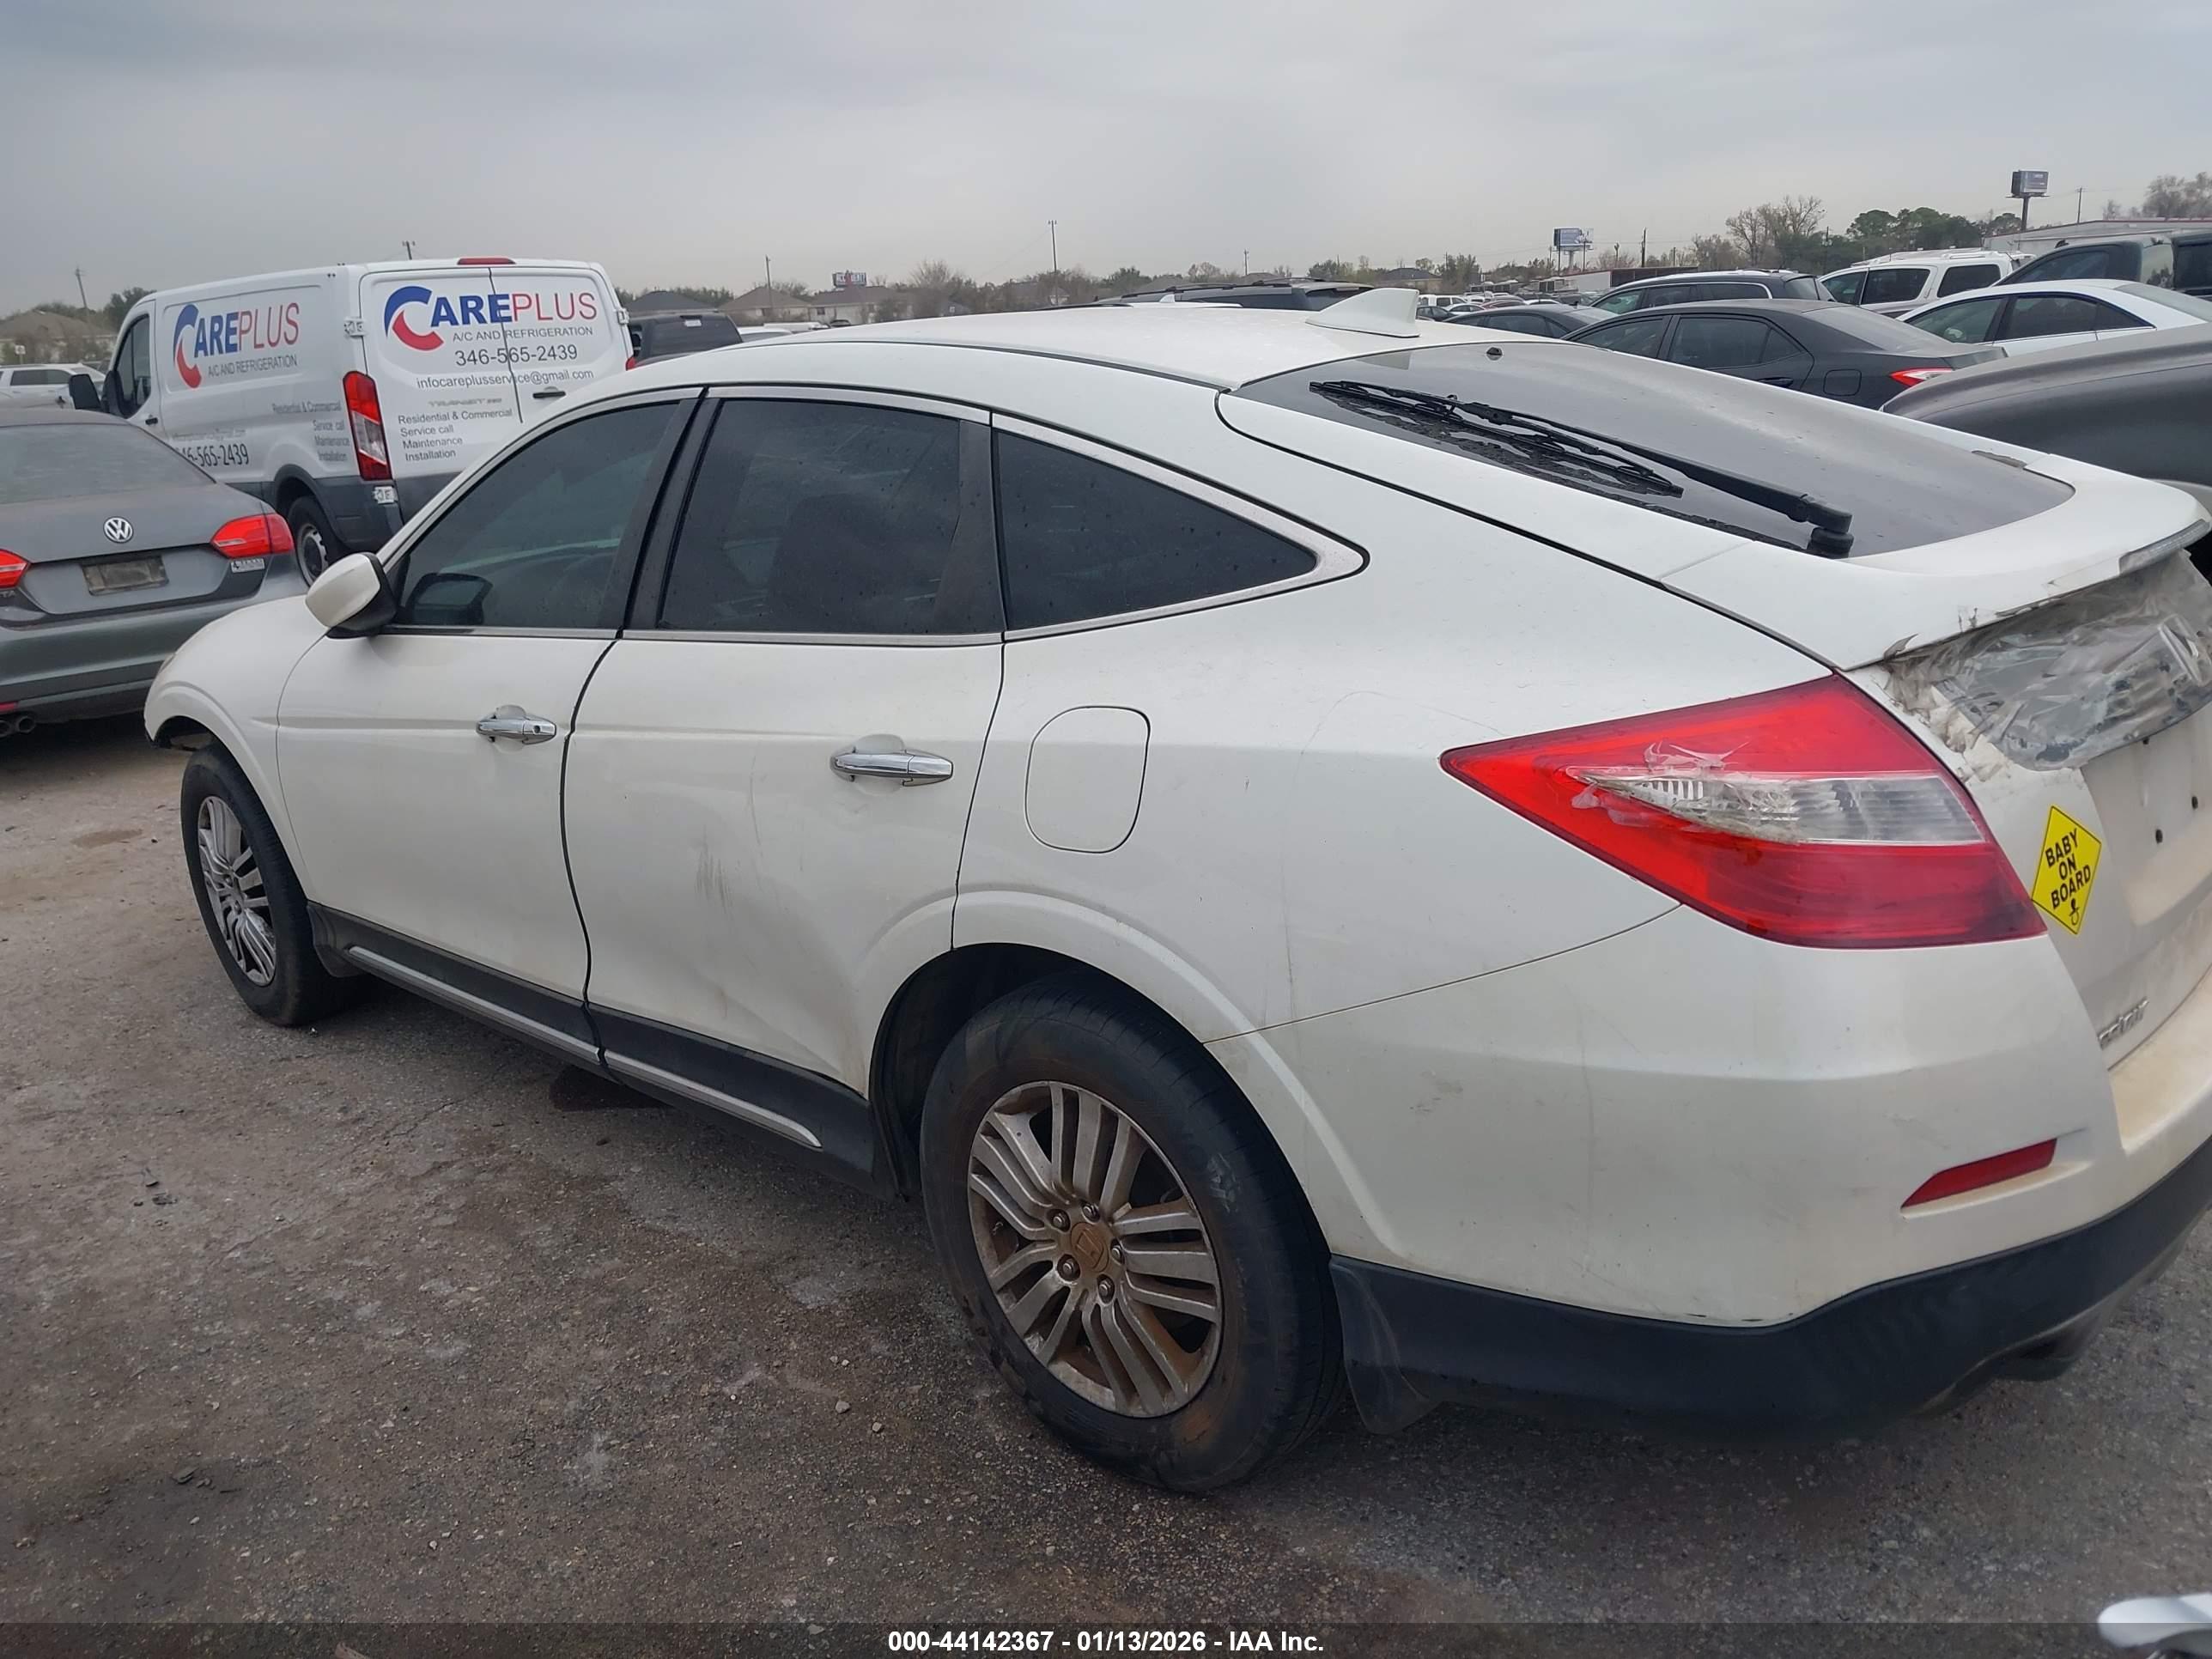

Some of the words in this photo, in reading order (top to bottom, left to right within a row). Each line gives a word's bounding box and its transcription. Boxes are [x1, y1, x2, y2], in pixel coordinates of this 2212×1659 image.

[385, 286, 598, 351] CAREPLUS
[453, 331, 473, 342] A/C
[476, 330, 501, 341] AND
[505, 326, 593, 339] REFRIGERATION
[173, 304, 300, 388] CAREPLUS
[455, 343, 578, 366] 346-565-2439
[221, 363, 234, 375] AND
[236, 355, 297, 373] REFRIGERATION
[398, 412, 450, 424] Residential
[452, 411, 459, 420] &
[461, 409, 513, 420] Commercial
[400, 427, 436, 437] Service
[438, 425, 454, 434] call
[403, 437, 463, 449] Maintenance
[405, 449, 456, 461] Installation
[2045, 828, 2078, 868] BABY
[2058, 854, 2077, 880] ON
[2051, 865, 2091, 909] BOARD
